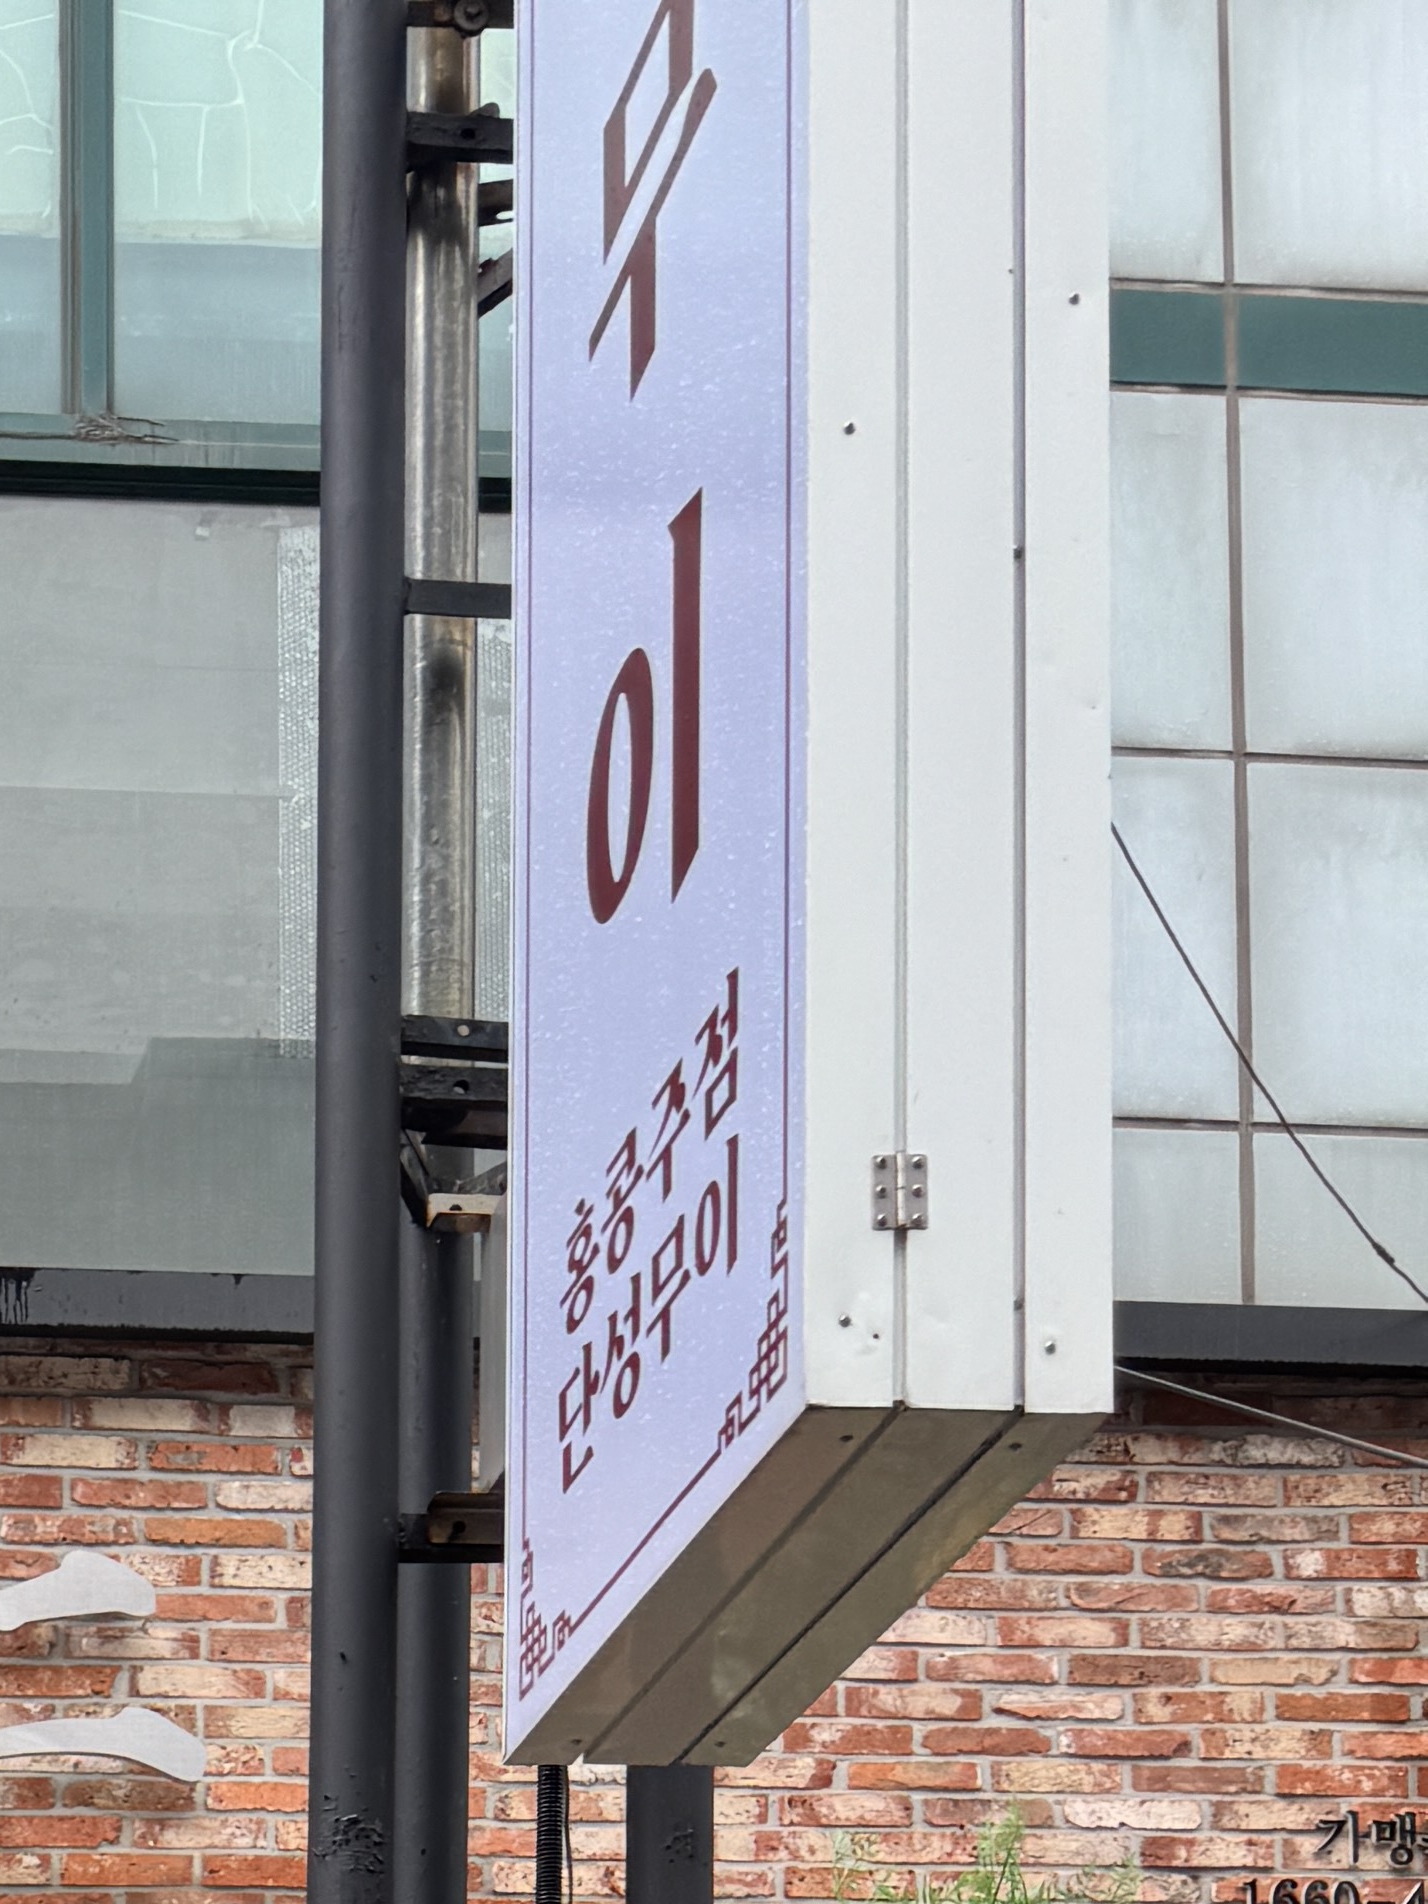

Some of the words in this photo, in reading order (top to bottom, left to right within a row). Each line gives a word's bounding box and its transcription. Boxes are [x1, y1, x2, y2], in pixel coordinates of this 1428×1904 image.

[558, 1133, 740, 1495] 단성무이
[559, 966, 740, 1336] 홍콩주점
[1314, 1809, 1428, 1866] 가맹
